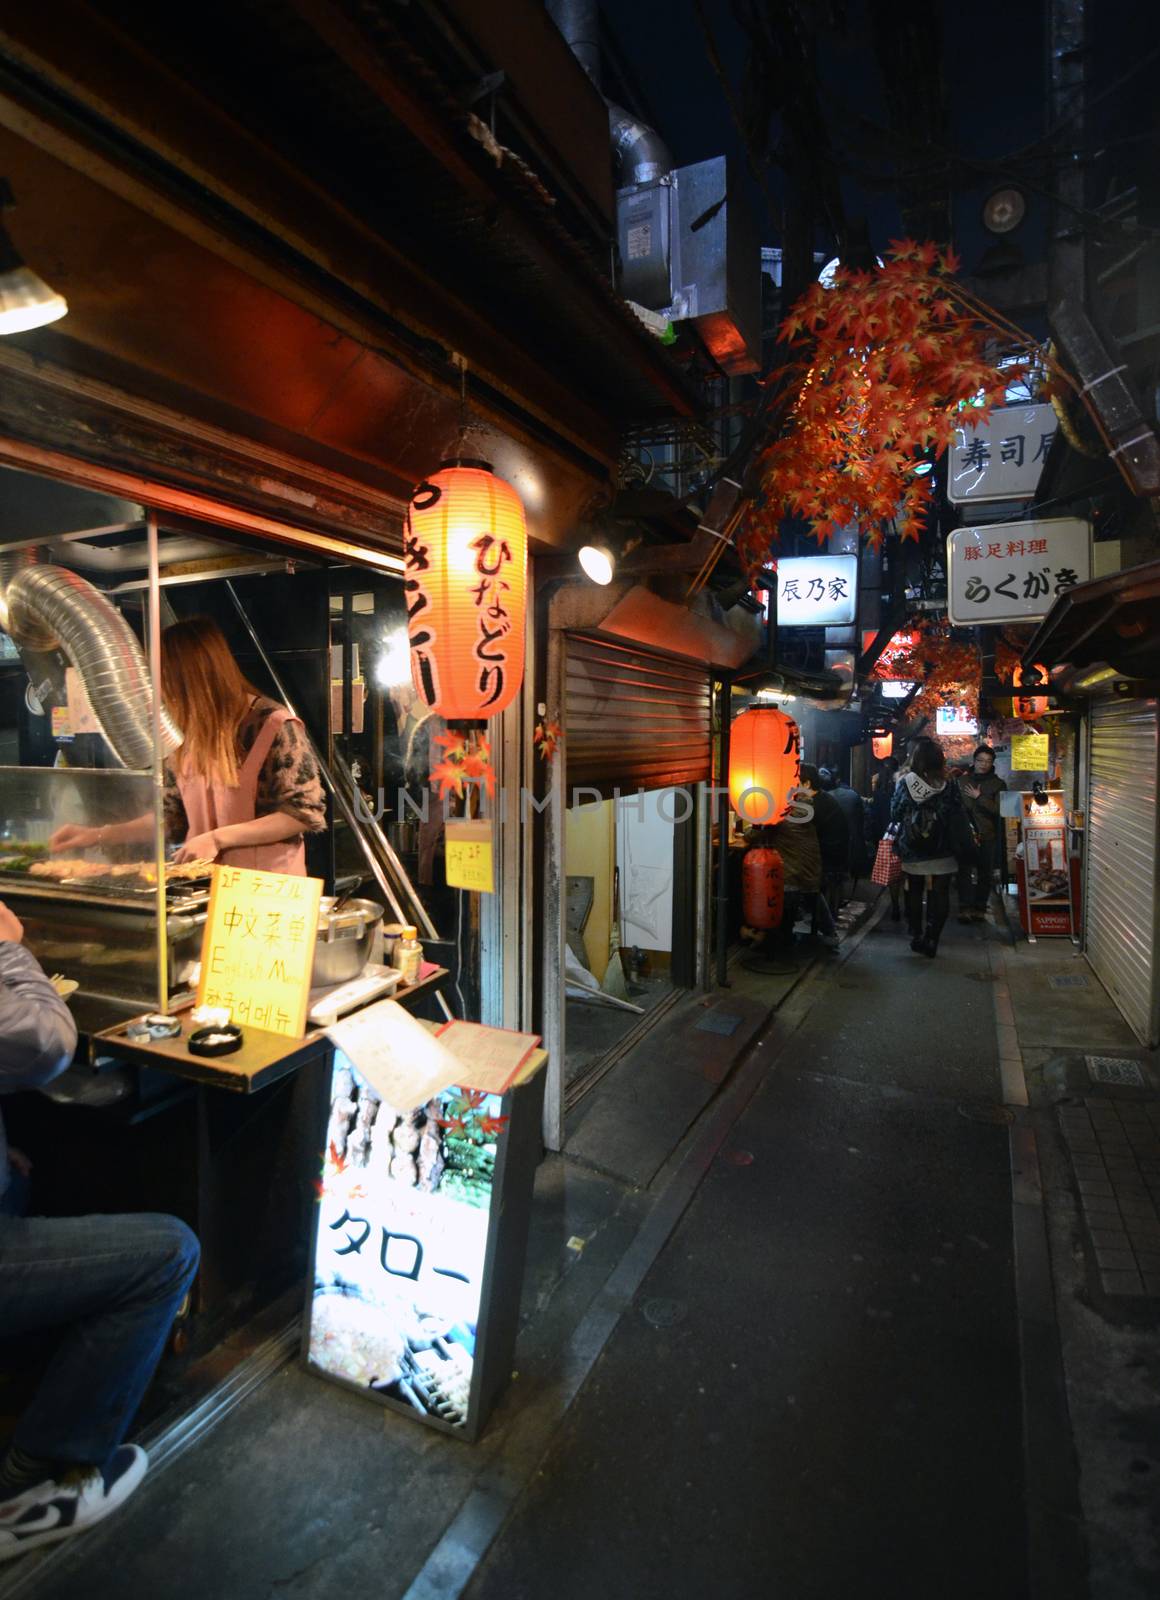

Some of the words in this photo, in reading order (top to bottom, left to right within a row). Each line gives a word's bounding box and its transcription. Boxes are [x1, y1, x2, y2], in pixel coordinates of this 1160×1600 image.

[964, 539, 1048, 560] 豚足料理
[782, 577, 848, 601] 辰乃家
[965, 567, 1079, 603] らくがき
[471, 534, 510, 708] ひなどり
[252, 876, 304, 898] テーブル
[211, 945, 263, 986] English
[329, 1208, 470, 1284] タロー
